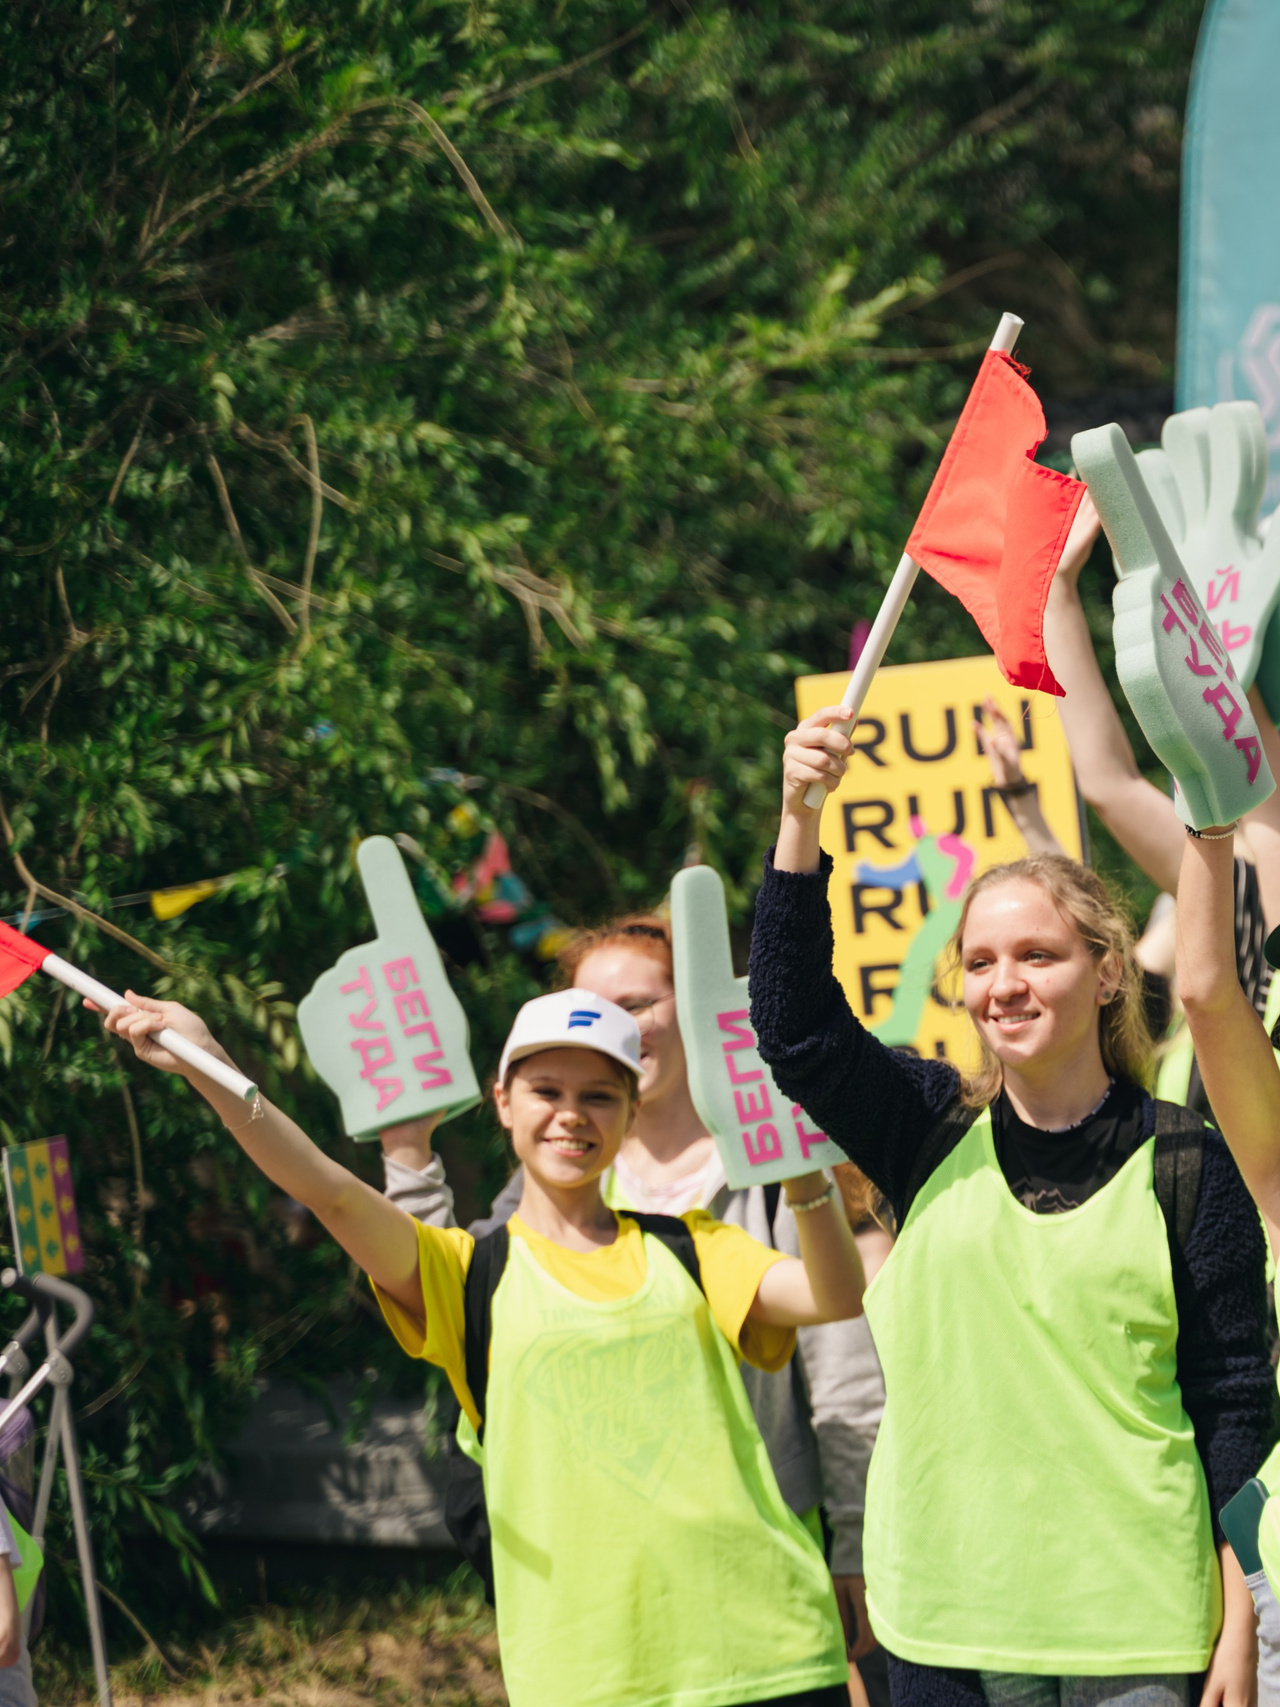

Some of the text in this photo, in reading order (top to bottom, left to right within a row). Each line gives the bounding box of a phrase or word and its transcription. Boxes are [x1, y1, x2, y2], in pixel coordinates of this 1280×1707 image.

[1160, 592, 1263, 785] ТУДА
[340, 964, 405, 1113] ТУДА
[381, 955, 453, 1091] БЕГИ
[716, 1008, 784, 1166] БЕГИ
